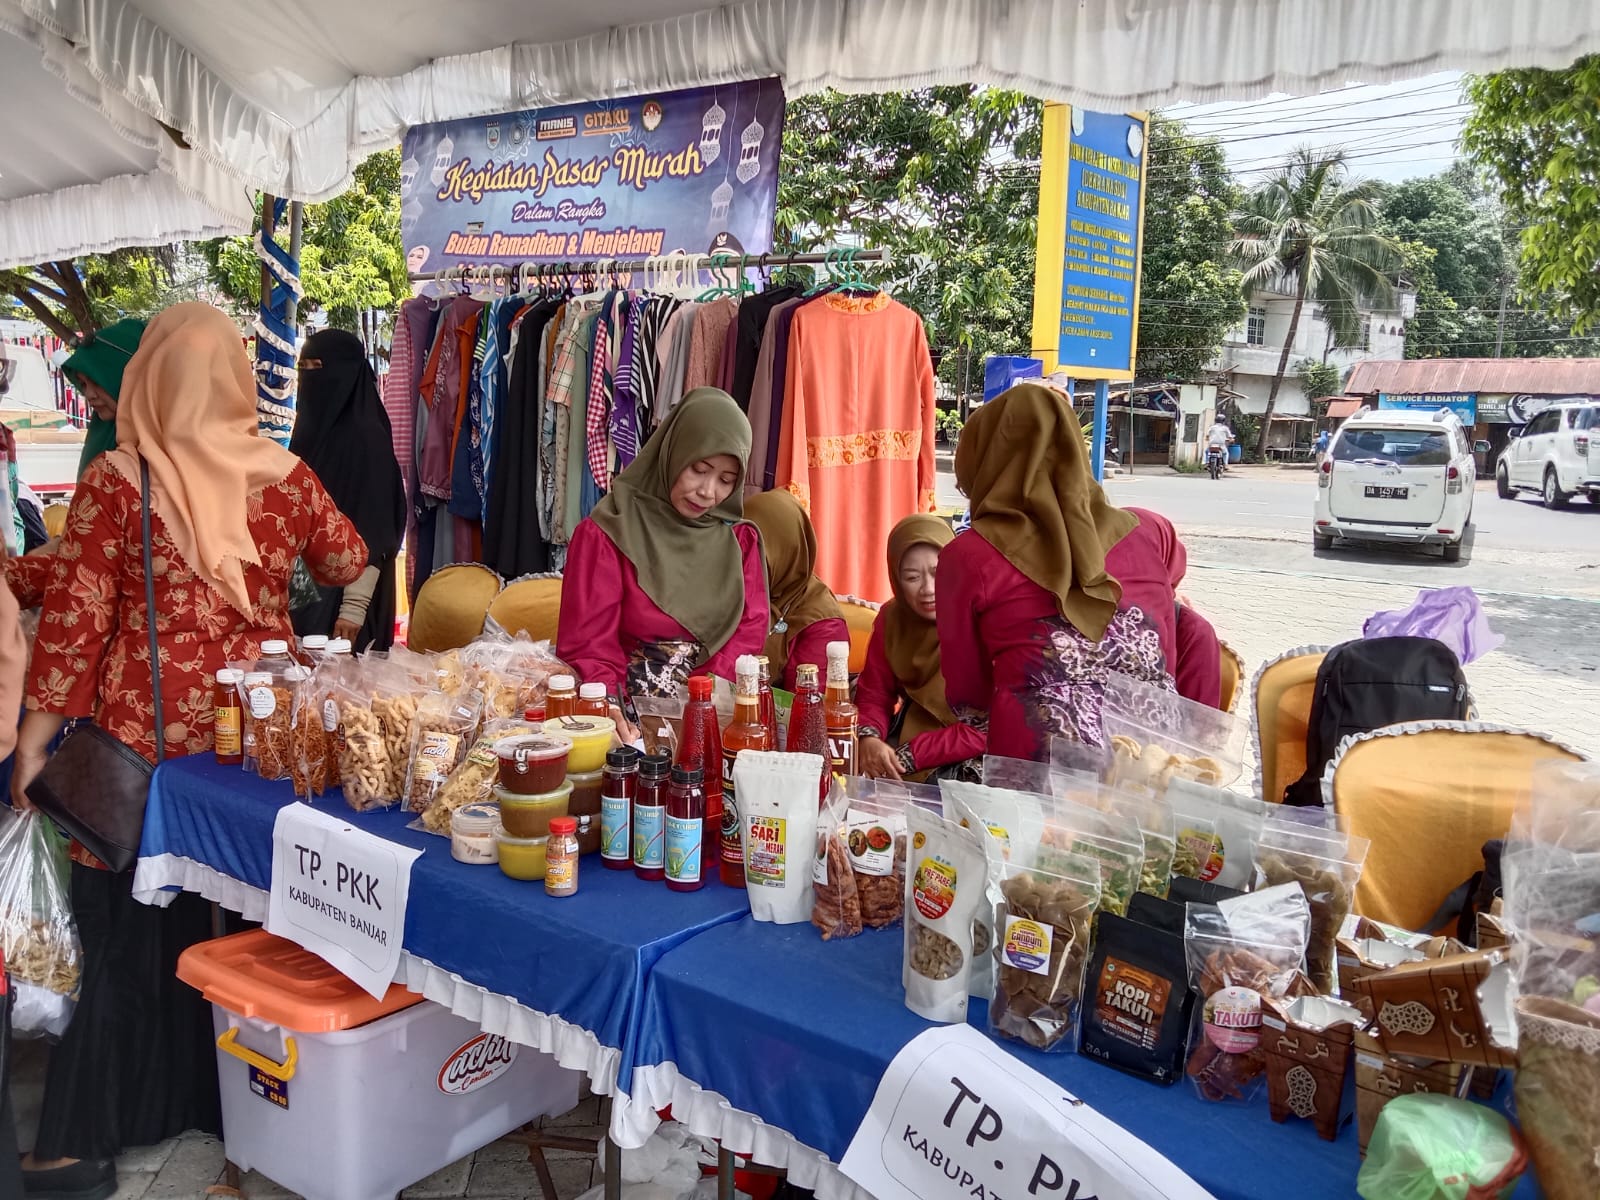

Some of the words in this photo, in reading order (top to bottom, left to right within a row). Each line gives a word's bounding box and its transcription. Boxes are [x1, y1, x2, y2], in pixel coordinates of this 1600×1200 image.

[540, 117, 574, 131] MANIS
[584, 108, 629, 128] GITAKU
[438, 159, 538, 202] Kegiatan
[533, 152, 609, 197] Pasar
[614, 141, 704, 189] Murah
[513, 203, 553, 221] Dalam
[557, 199, 605, 224] Rangka
[444, 233, 490, 254] Bulan
[488, 231, 567, 256] Ramadhan
[566, 234, 578, 256] &
[579, 228, 664, 257] Menjelang
[1366, 486, 1375, 495] DA
[1379, 487, 1395, 496] 1457
[765, 842, 784, 855] MERAH
[294, 844, 327, 886] TP.
[336, 862, 382, 911] PKK
[289, 885, 347, 925] KABUPATEN
[350, 914, 387, 947] BANJAR
[1115, 979, 1151, 1006] KOPI
[1105, 990, 1154, 1025] TAKUTI
[1215, 1010, 1263, 1026] TAKUTI
[257, 1072, 280, 1090] STACK
[942, 1076, 1004, 1170] TP.
